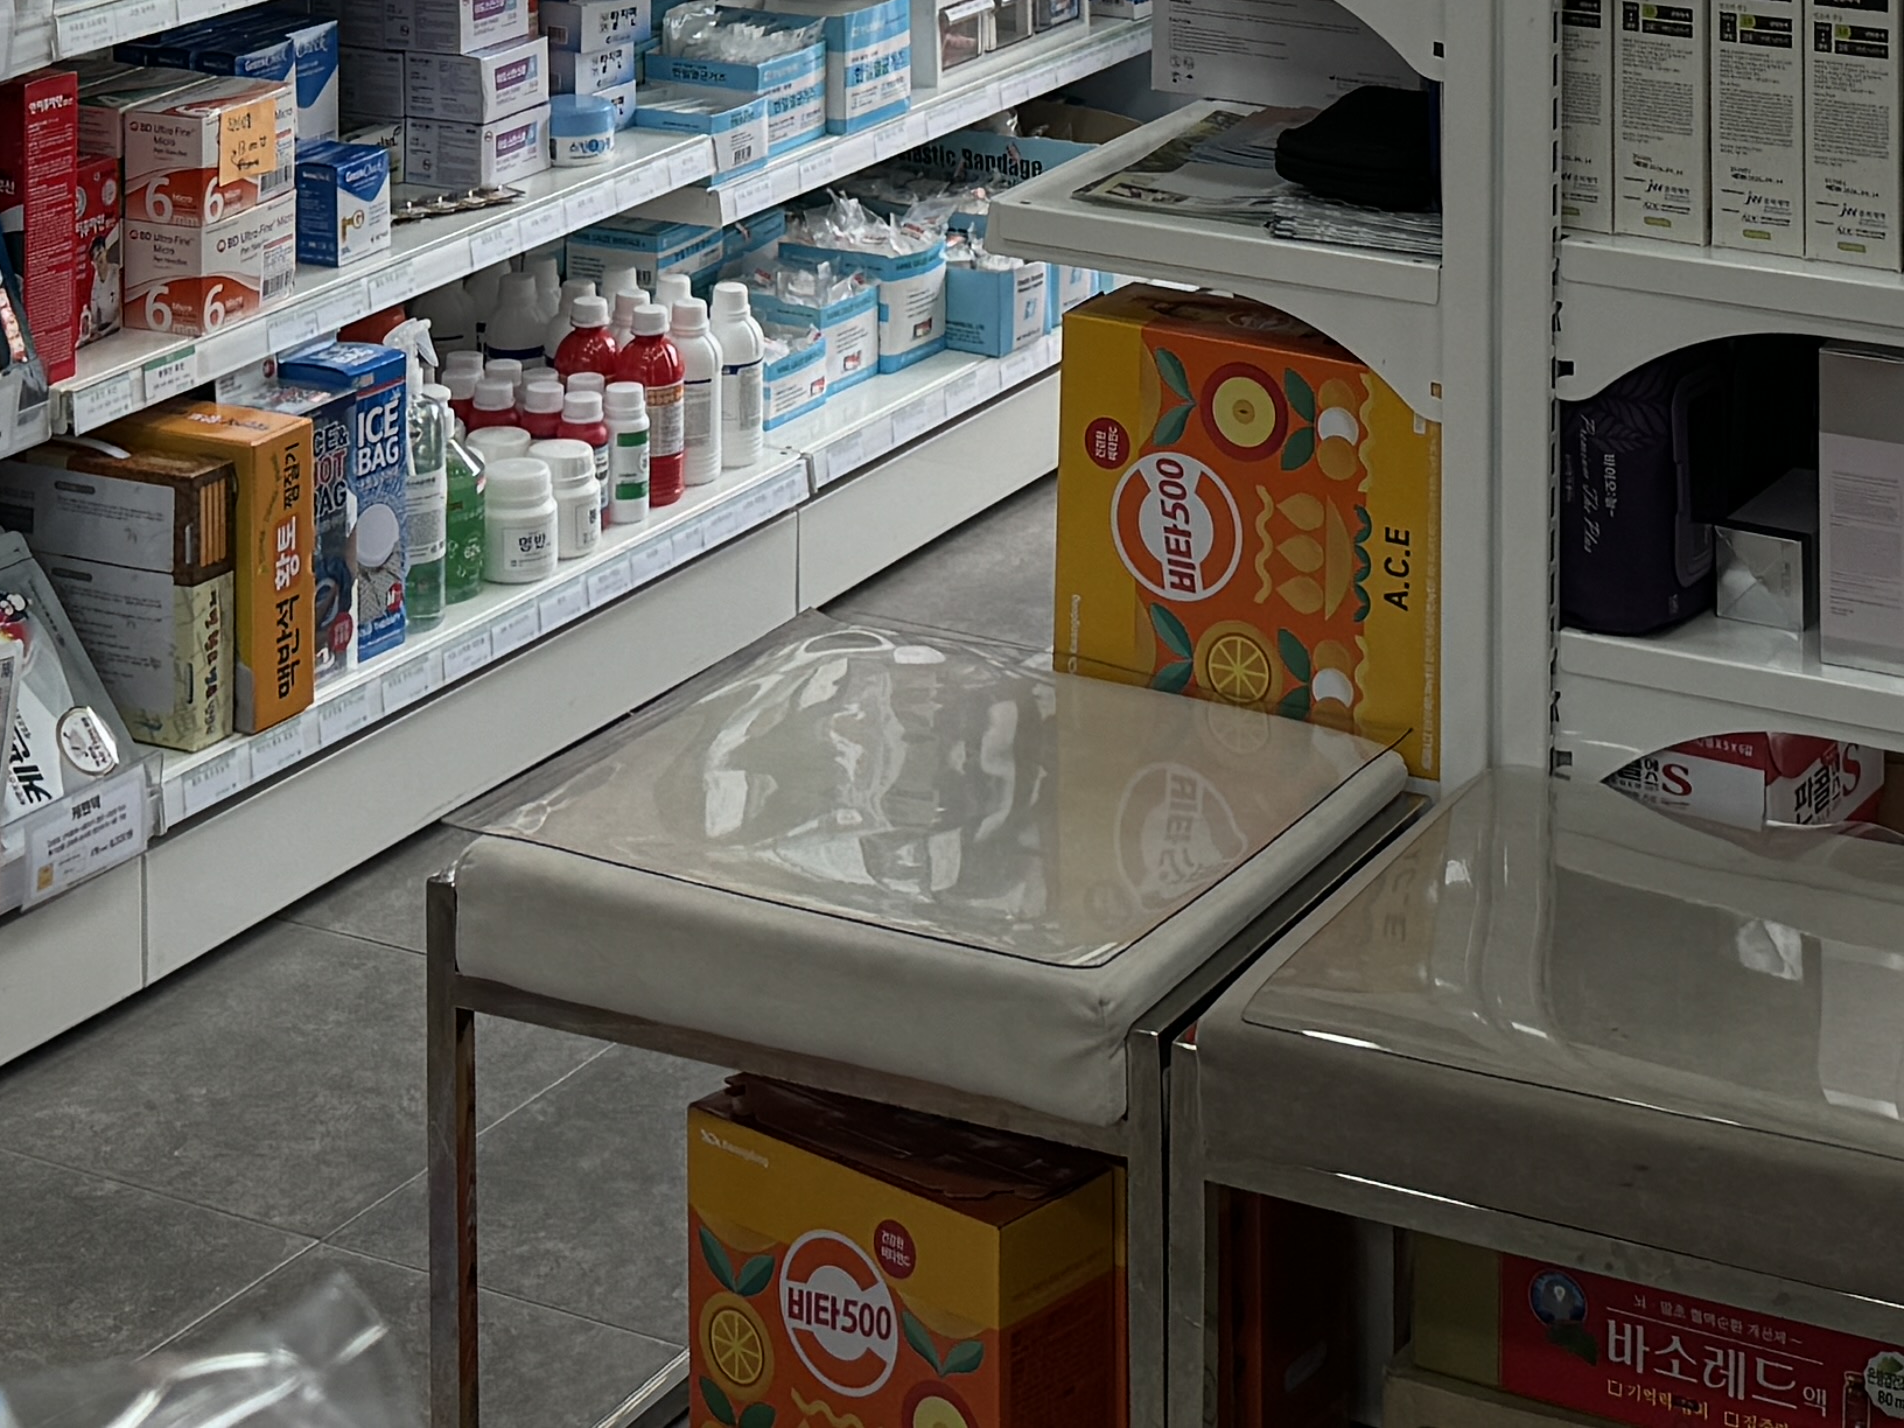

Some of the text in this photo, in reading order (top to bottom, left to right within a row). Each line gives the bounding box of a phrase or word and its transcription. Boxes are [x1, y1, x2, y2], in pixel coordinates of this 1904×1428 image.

[962, 148, 1043, 181] Bandage
[357, 398, 400, 442] ICE
[359, 442, 400, 477] BAG
[1155, 457, 1198, 595] 비타500
[1383, 526, 1411, 612] A.C.E
[787, 1287, 892, 1342] 비타500
[1607, 1318, 1798, 1409] 바소레드
[1803, 1385, 1827, 1418] 액
